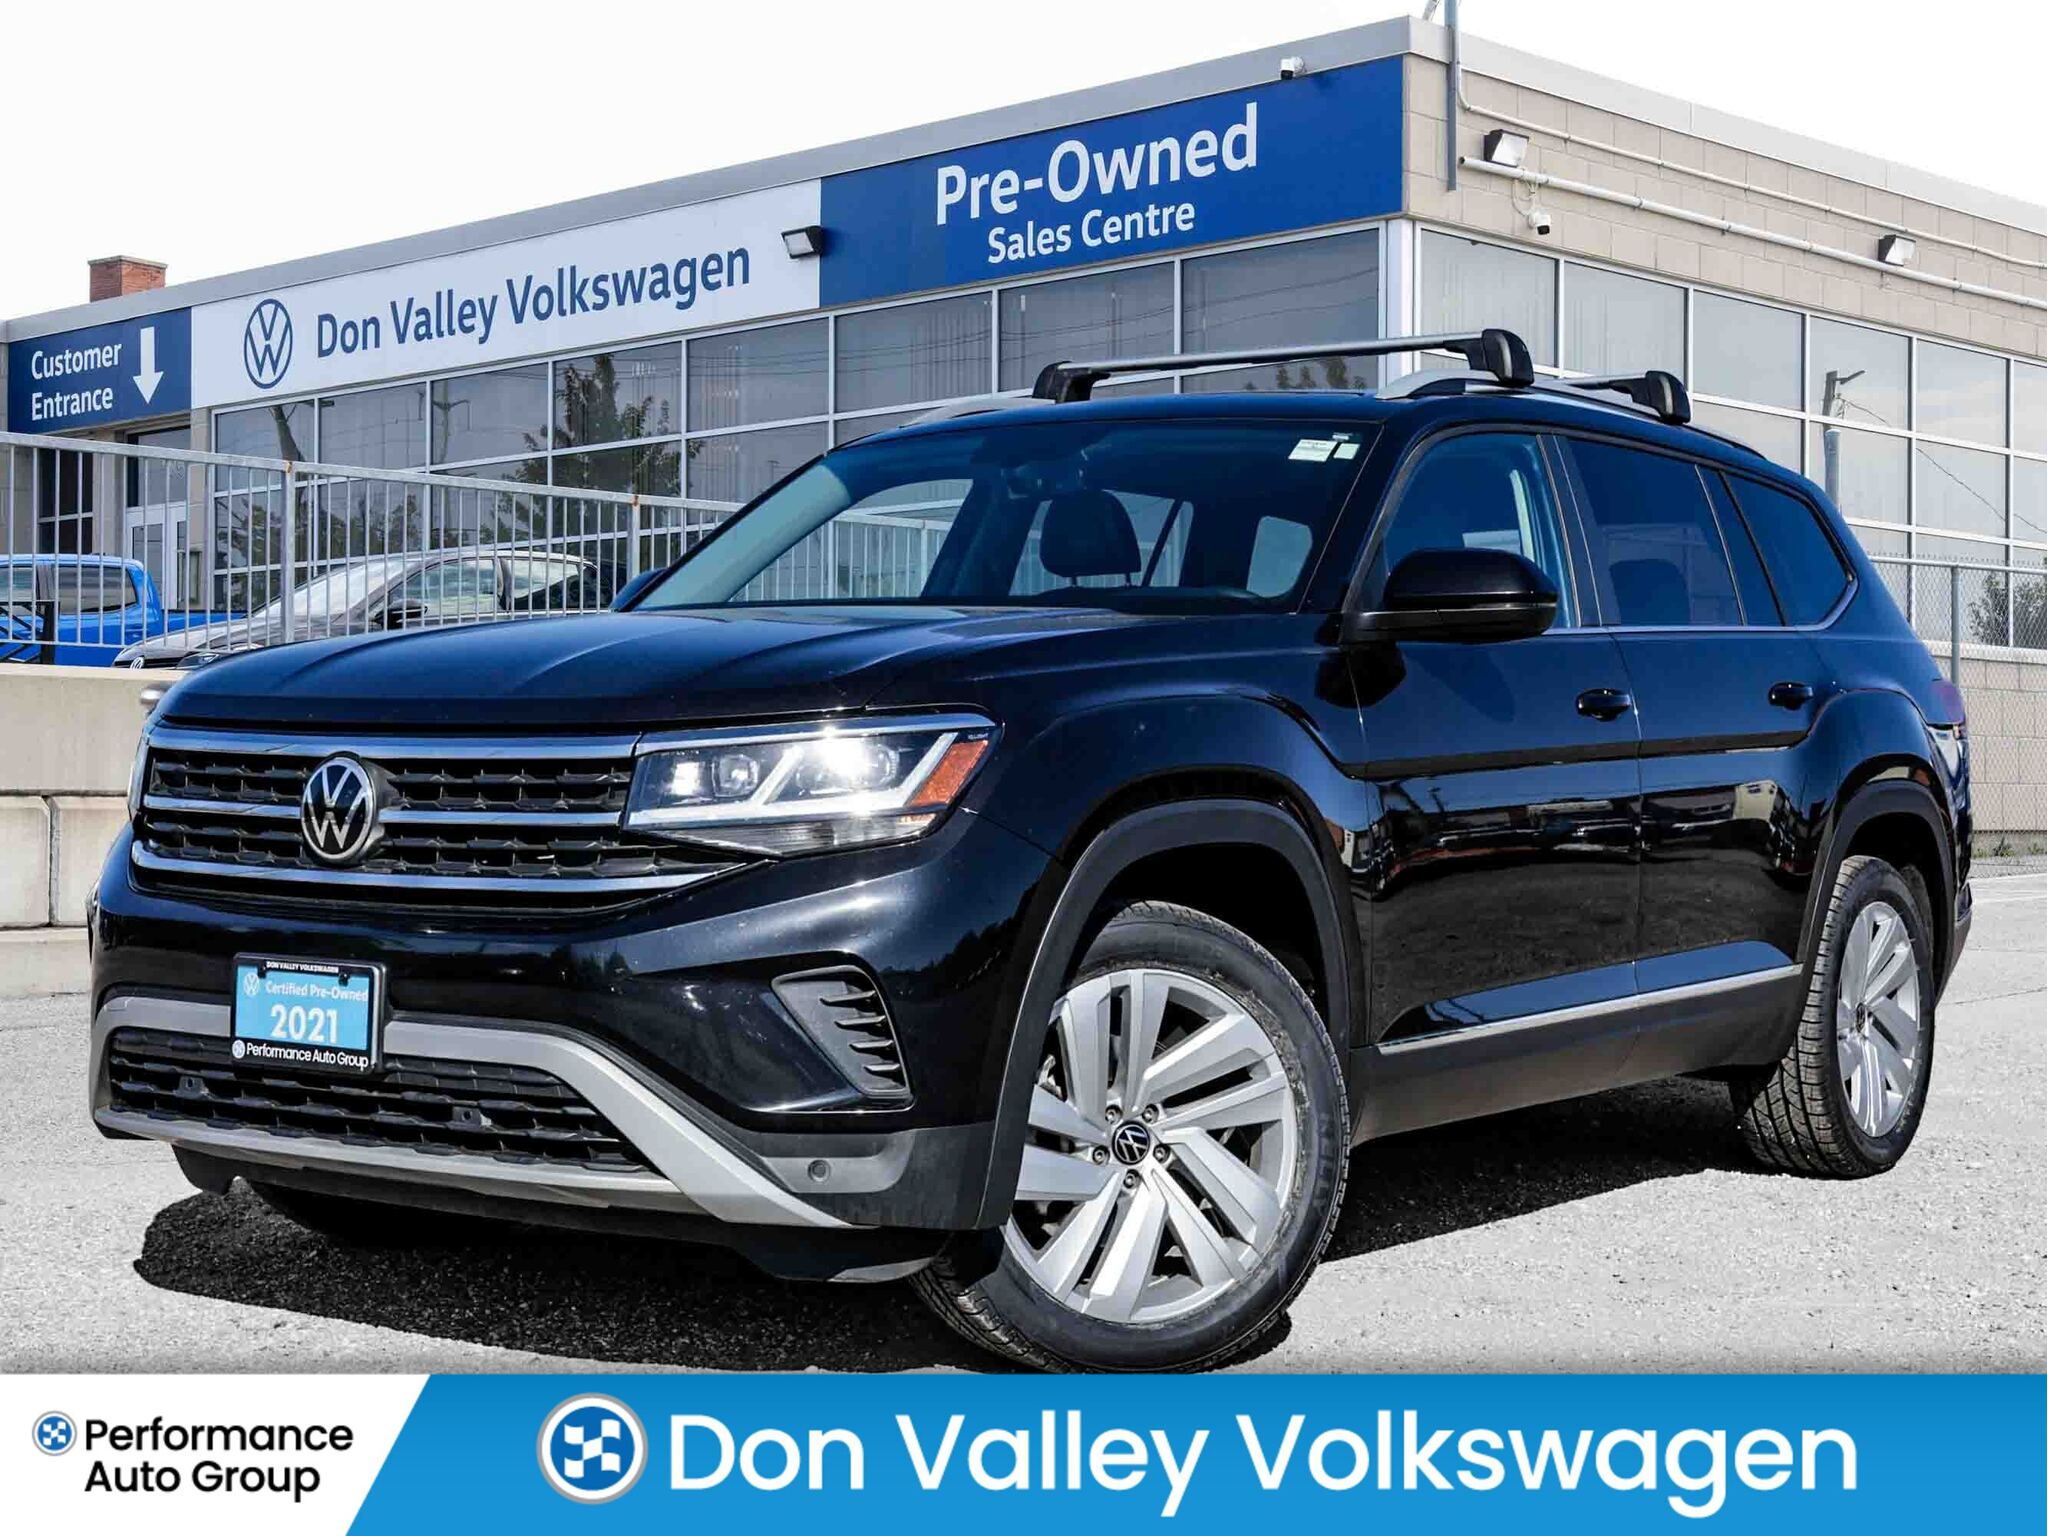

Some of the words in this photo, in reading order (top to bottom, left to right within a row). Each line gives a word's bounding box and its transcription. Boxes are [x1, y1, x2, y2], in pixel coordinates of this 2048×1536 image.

[936, 102, 1258, 226] Pre-Owned
[987, 221, 1072, 264] Sales
[1081, 202, 1195, 248] Centre
[317, 313, 381, 358] Don
[390, 289, 499, 345] Valley
[506, 246, 750, 324] Volkswagen
[31, 343, 122, 380] Customer
[31, 387, 114, 421] Entrance
[265, 981, 308, 996] Certified
[310, 985, 369, 1001] Pre-Owned
[270, 1003, 338, 1044] 2021
[246, 1042, 312, 1062] Performance
[312, 1049, 336, 1064] Auto
[337, 1052, 369, 1071] Group
